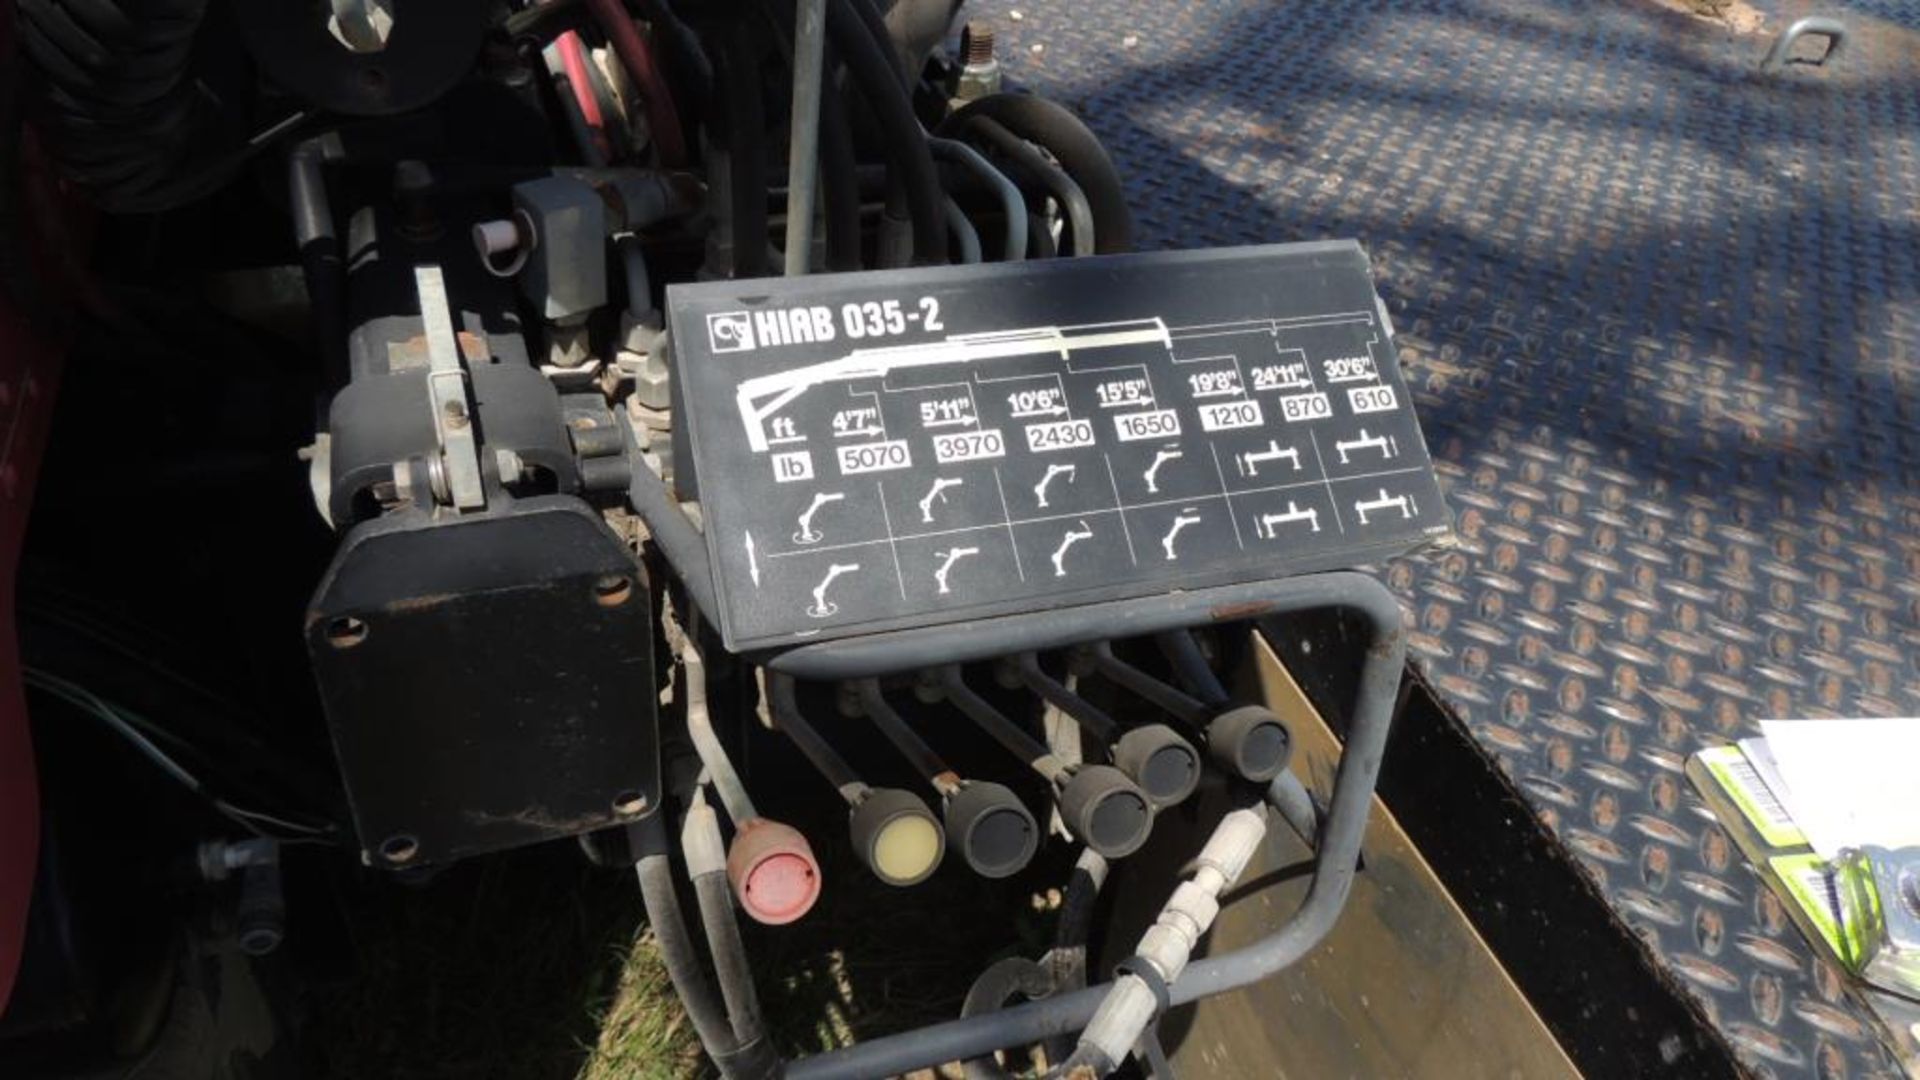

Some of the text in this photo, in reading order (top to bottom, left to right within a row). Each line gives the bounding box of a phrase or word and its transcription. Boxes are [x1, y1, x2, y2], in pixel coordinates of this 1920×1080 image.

[755, 297, 945, 347] HIAB 035-2
[771, 417, 796, 437] ft
[781, 389, 1392, 478] lb 5070 3970 2430 1650 1210 870 610
